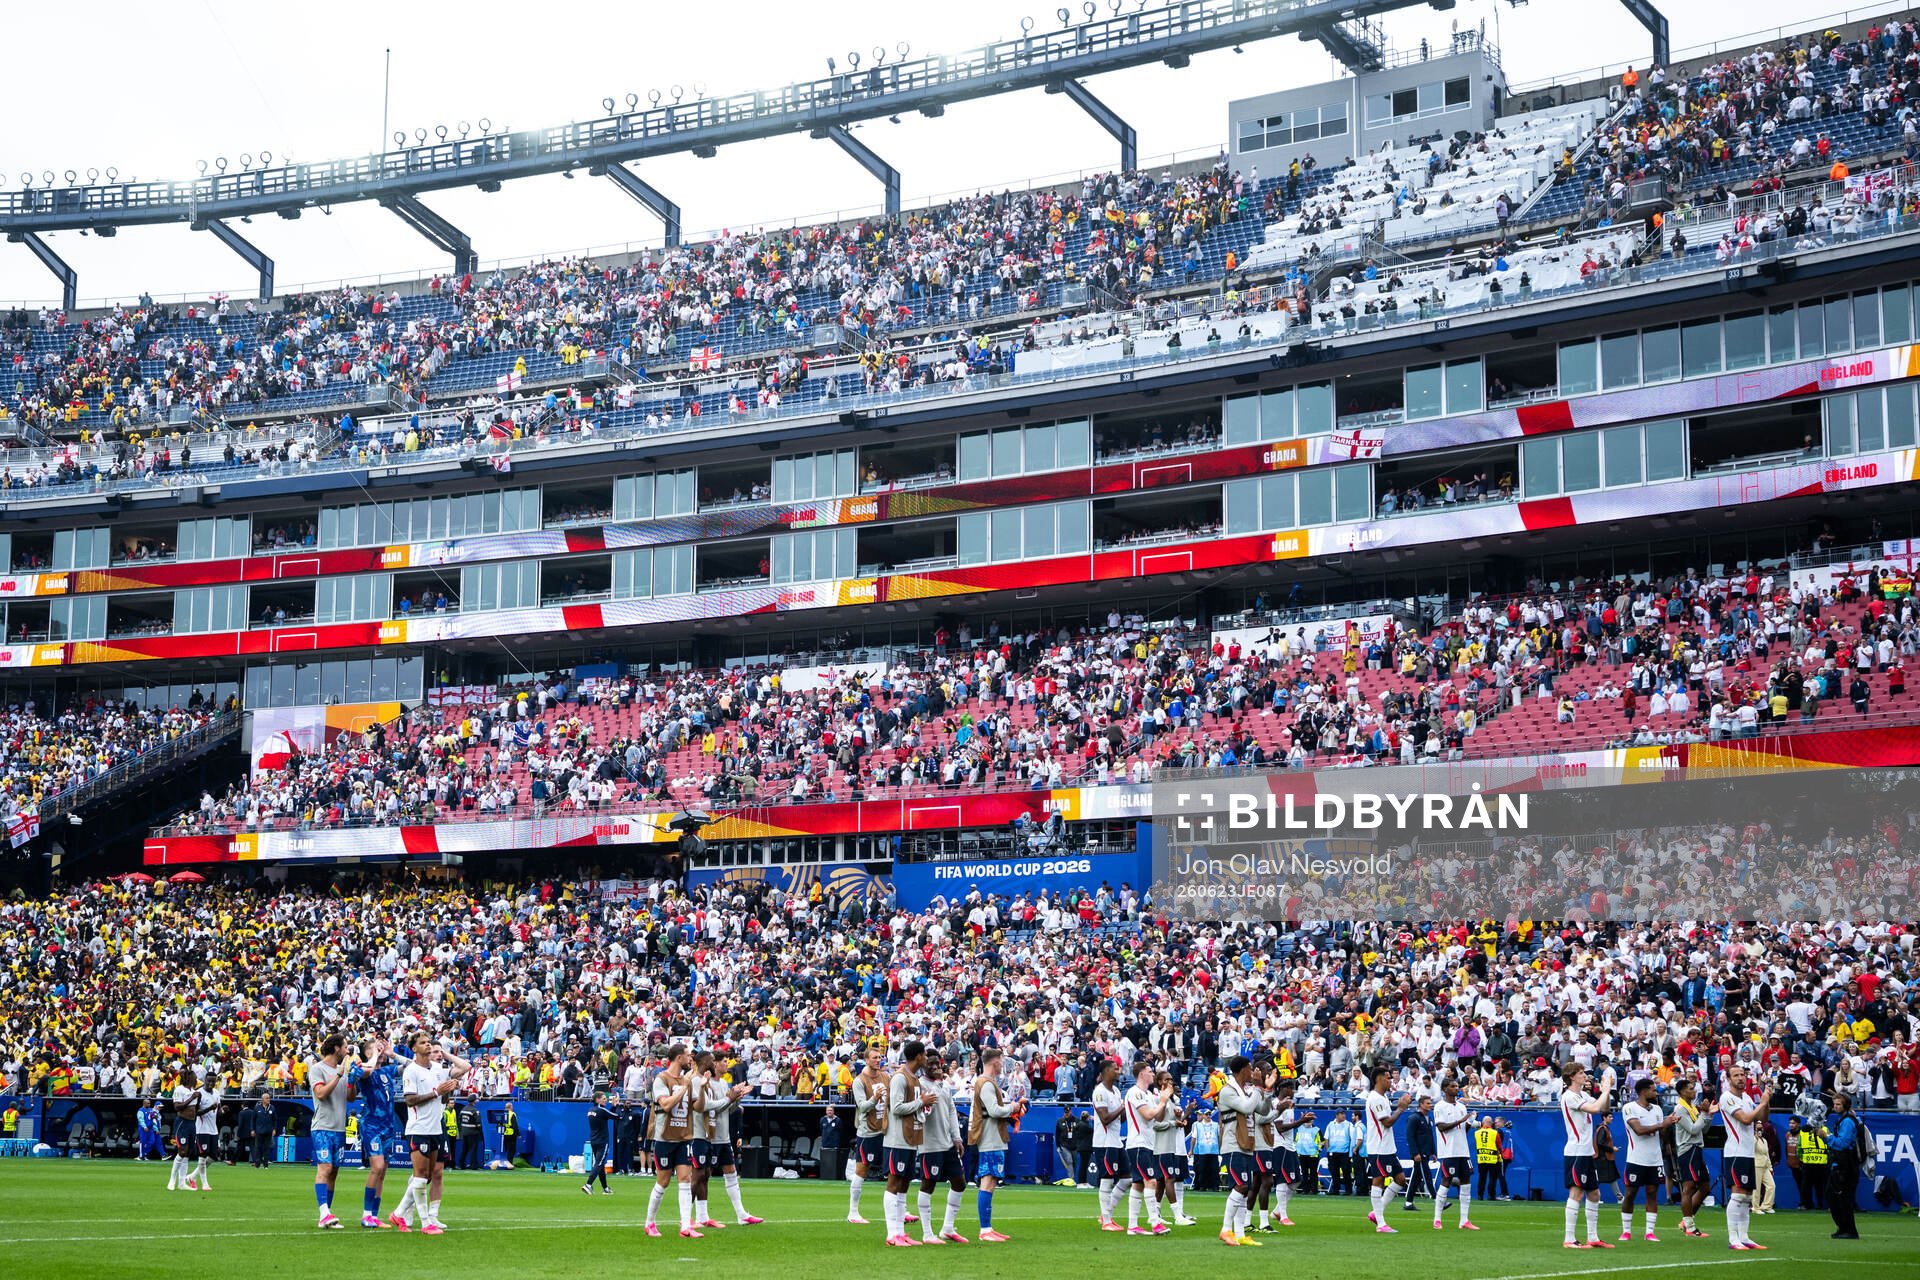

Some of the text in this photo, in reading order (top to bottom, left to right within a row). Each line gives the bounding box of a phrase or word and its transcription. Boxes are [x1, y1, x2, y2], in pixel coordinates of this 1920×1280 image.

[1728, 269, 1740, 280] 333
[1436, 321, 1448, 330] 332
[1821, 360, 1873, 381] ENGLAND
[1331, 435, 1370, 446] BARNSLEY
[1263, 448, 1297, 464] GHANA
[1825, 463, 1878, 483] ENGLAND
[850, 502, 878, 515] GHANA
[779, 509, 817, 524] ENGLAND
[45, 578, 68, 589] GHANA
[849, 584, 878, 597] GHANA
[1536, 763, 1587, 779] ENGLAND
[1639, 756, 1680, 772] GHANA
[593, 824, 630, 837] ENGLAND
[935, 860, 1091, 879] FIFA WORLD CUP 2026
[1783, 1082, 1799, 1096] 24
